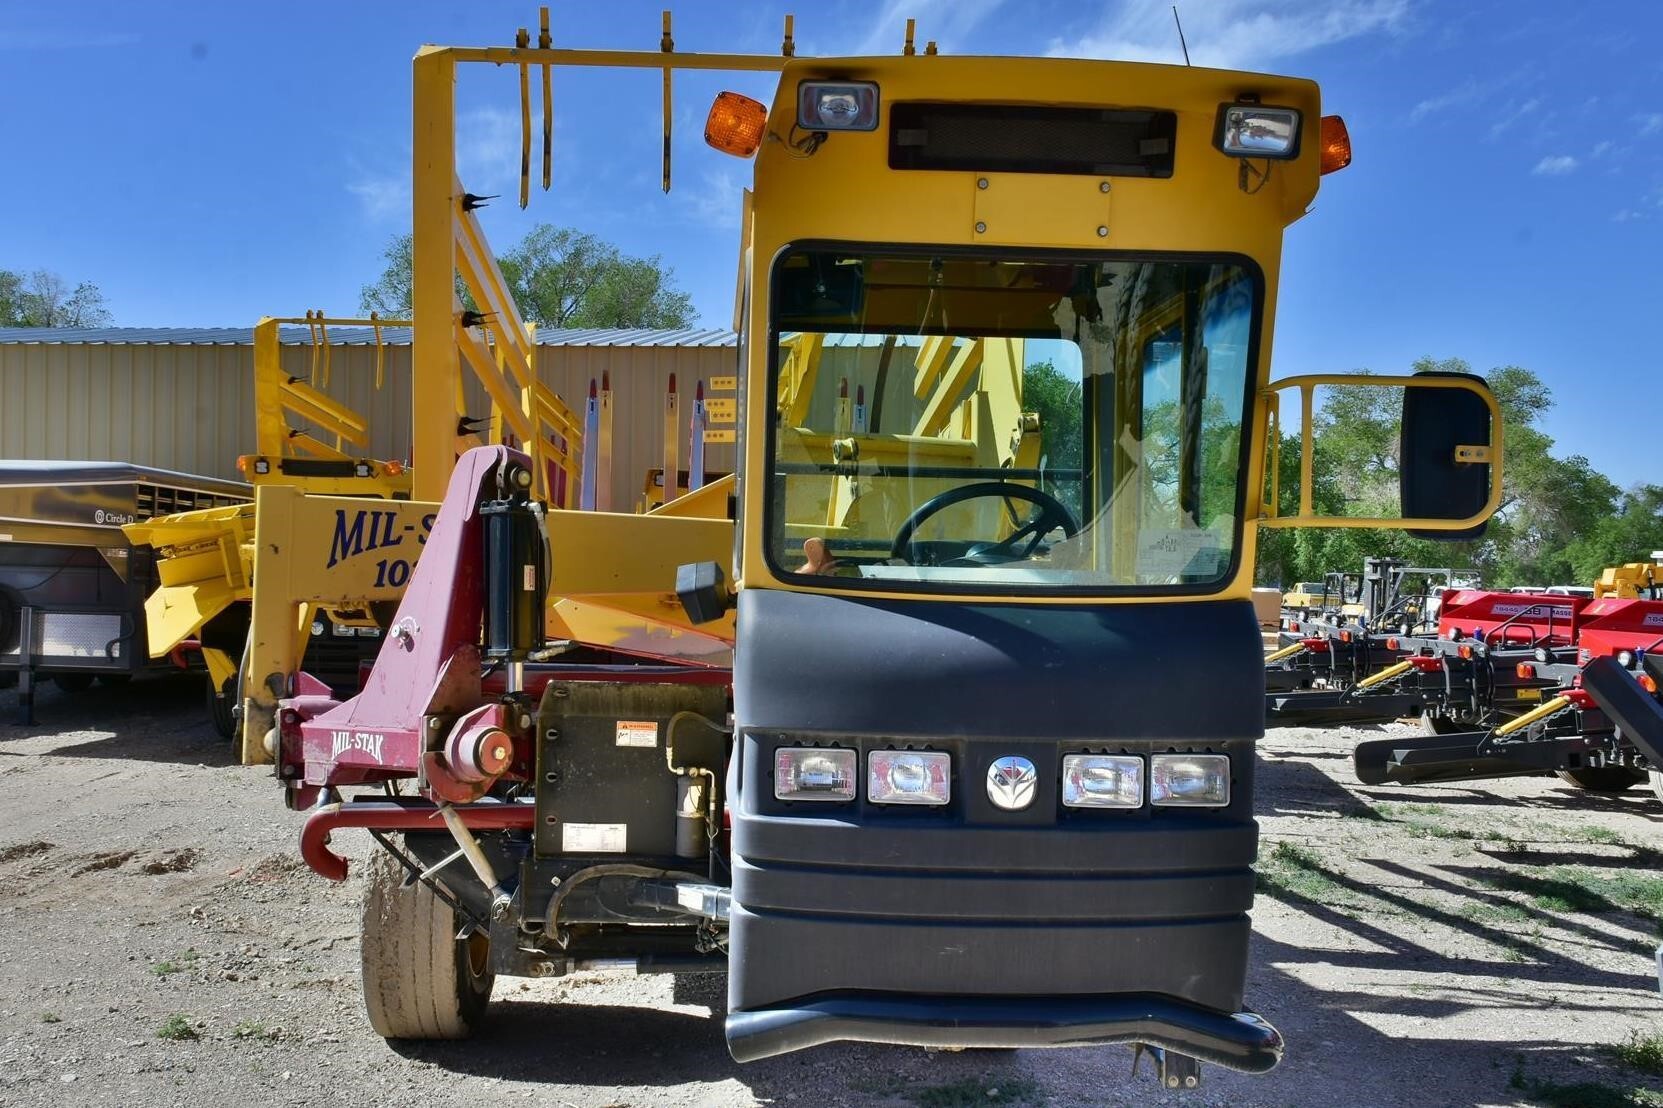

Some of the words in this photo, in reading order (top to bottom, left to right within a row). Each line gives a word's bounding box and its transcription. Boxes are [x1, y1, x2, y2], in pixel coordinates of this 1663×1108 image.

[105, 513, 126, 523] Circle
[127, 515, 134, 523] D
[373, 559, 418, 588] 10
[331, 731, 384, 765] MIL-STAK
